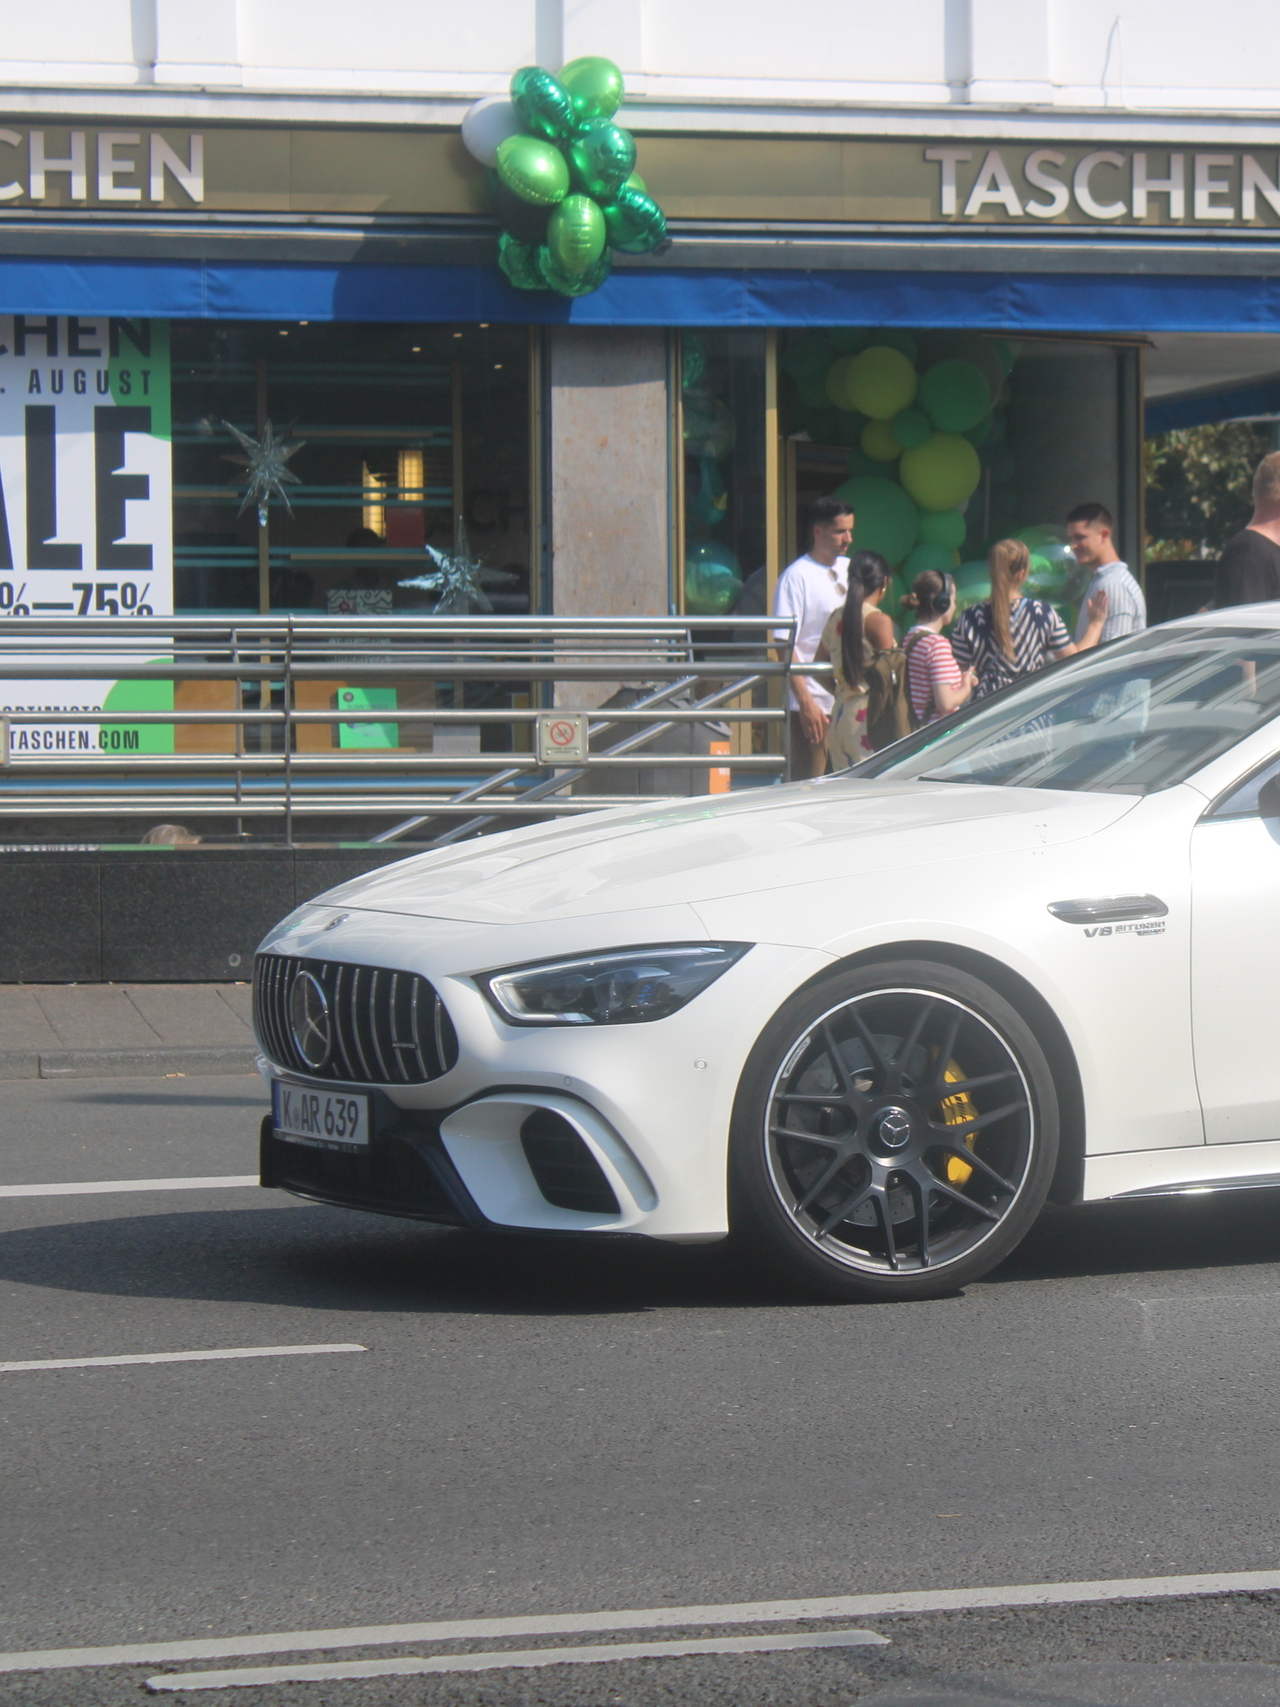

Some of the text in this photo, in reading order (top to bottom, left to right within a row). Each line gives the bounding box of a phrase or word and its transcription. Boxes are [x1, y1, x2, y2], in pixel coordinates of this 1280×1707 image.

[0, 315, 152, 358] HEN
[28, 368, 151, 395] AUGUST
[0, 404, 154, 571] LE
[10, 729, 140, 750] TASCHEN.COM
[1083, 922, 1165, 938] V8 BITURBO
[284, 1090, 359, 1138] K AR 639
